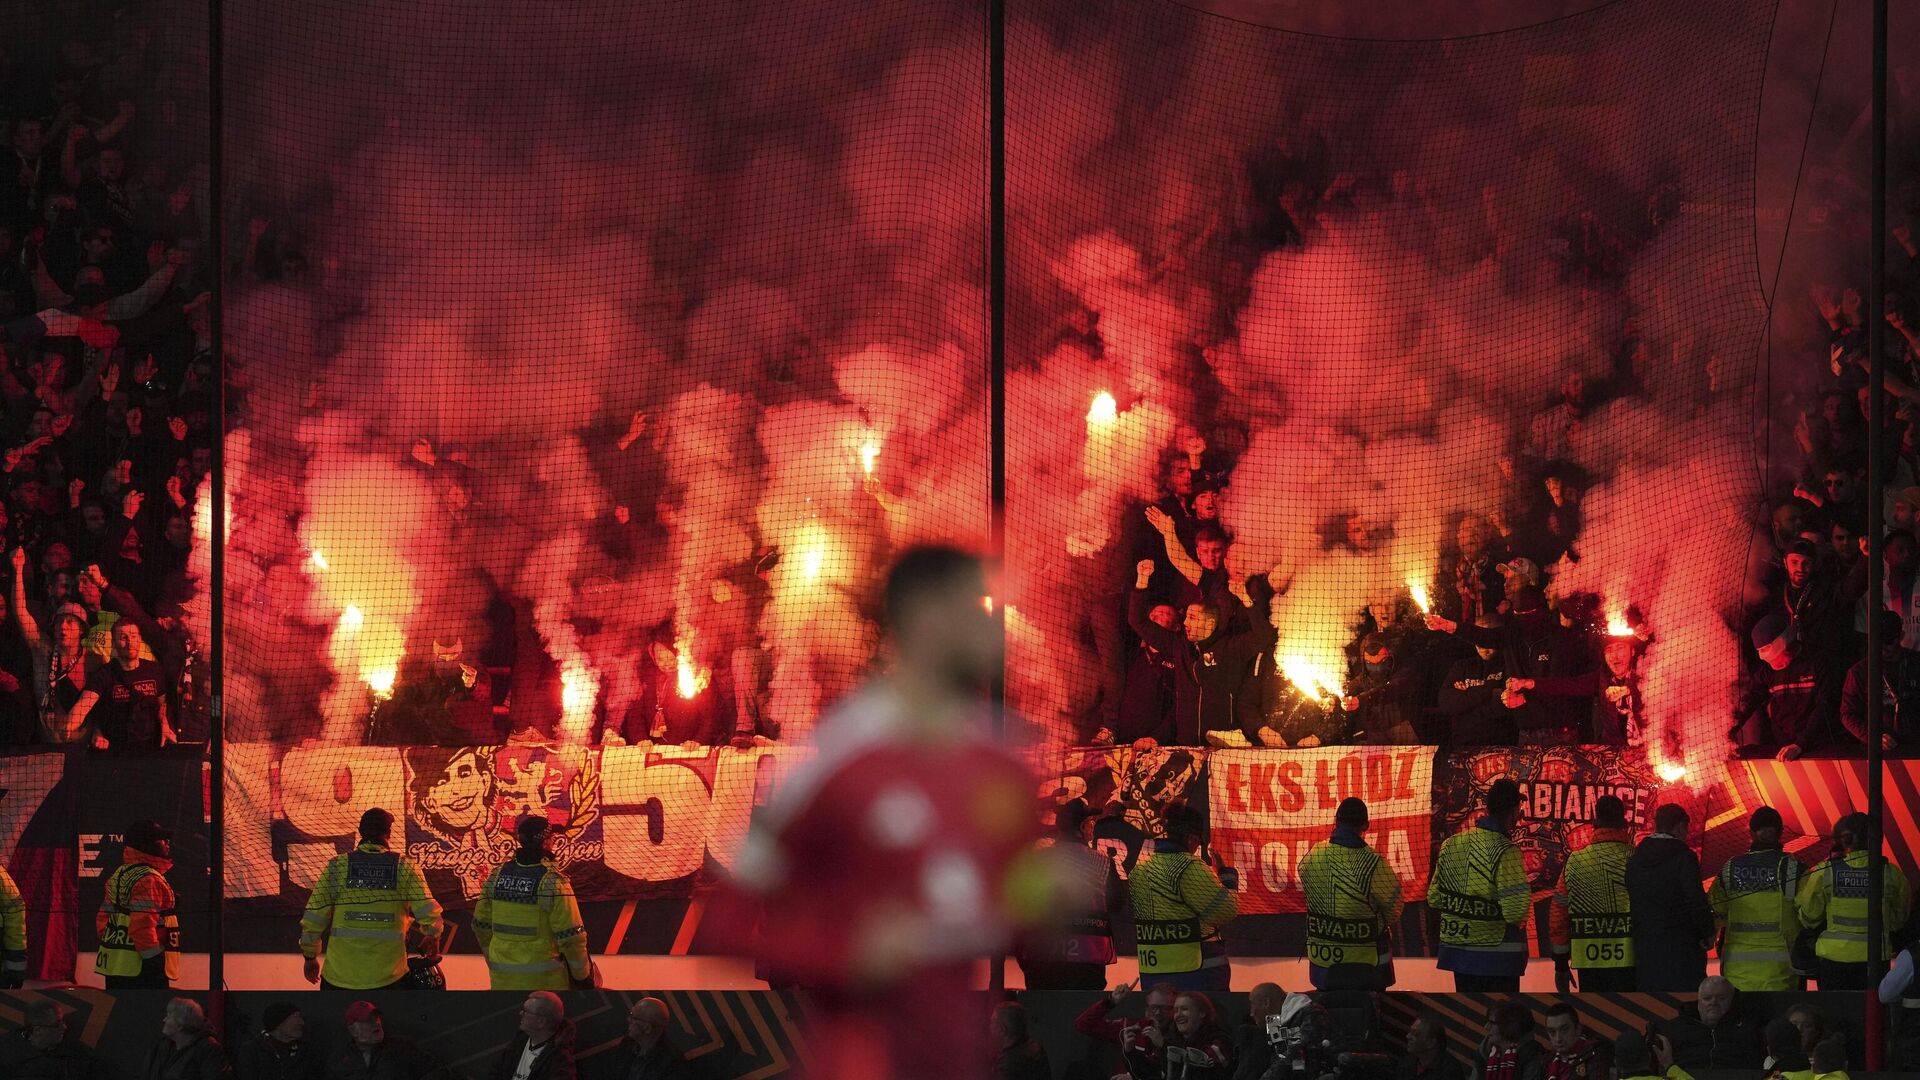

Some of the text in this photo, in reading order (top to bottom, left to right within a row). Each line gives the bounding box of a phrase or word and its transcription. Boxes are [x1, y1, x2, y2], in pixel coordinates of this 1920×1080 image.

[1519, 783, 1649, 824] ABIANCE
[408, 841, 487, 877] Virage
[1734, 866, 1776, 881] POLICE
[496, 876, 534, 893] POLICE
[1844, 878, 1870, 888] POLIC
[1586, 943, 1625, 961] 055
